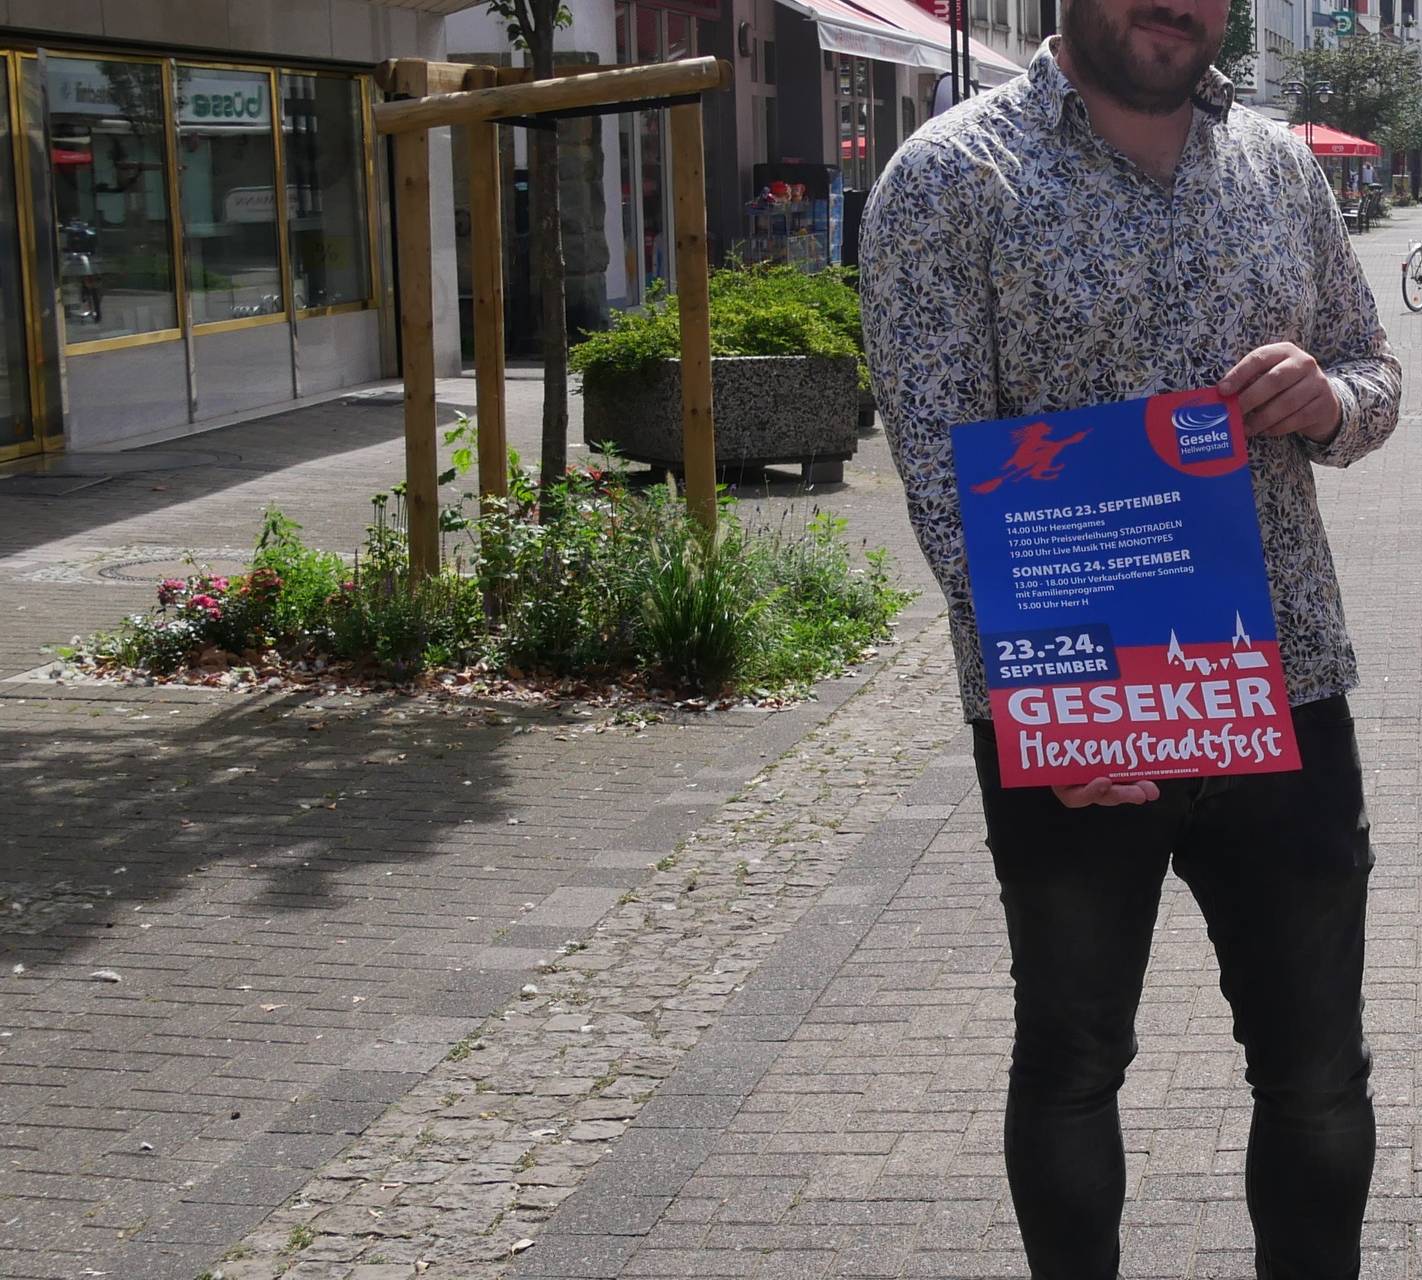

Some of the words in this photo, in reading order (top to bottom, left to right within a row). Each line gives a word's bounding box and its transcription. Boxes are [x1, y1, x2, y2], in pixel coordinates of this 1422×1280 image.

[1180, 431, 1228, 446] Geseke
[1181, 442, 1229, 455] Hellwegstadt
[1005, 507, 1072, 523] SAMSTAG
[1075, 505, 1096, 517] 23.
[1099, 491, 1181, 513] SEPTEMBER
[1007, 526, 1030, 535] 14.00
[1032, 524, 1048, 533] Uhr
[1049, 519, 1105, 531] Hexengames
[1009, 539, 1032, 547] 17.00
[1034, 537, 1049, 545] Uhr
[1052, 529, 1118, 543] Preisverleihung
[1120, 520, 1183, 535] STADTRADELN
[1010, 550, 1033, 559] 19.00
[1035, 548, 1051, 557] Uhr
[1053, 545, 1070, 555] Live
[1072, 543, 1098, 553] Musik
[1100, 542, 1117, 550] THE
[1118, 534, 1173, 548] MONOTYPES
[1012, 562, 1081, 578] SONNTAG
[1084, 560, 1105, 572] 24.
[1108, 549, 1191, 569] SEPTEMBER
[1015, 580, 1038, 589] 13.00
[1046, 578, 1069, 587] 18.00
[1070, 575, 1086, 584] Uhr
[1088, 570, 1156, 583] Verkaufsoffener
[1158, 565, 1194, 576] Sonntag
[1032, 584, 1114, 597] Familienprogramm
[1017, 601, 1041, 610] 15.00
[1043, 601, 1059, 609] Uhr
[1082, 598, 1089, 606] H
[996, 633, 1104, 661] 23.-24.
[999, 658, 1108, 679] SEPTEMBER
[1008, 677, 1277, 725] GESEKER
[1019, 723, 1282, 770] Hexenstadtfest
